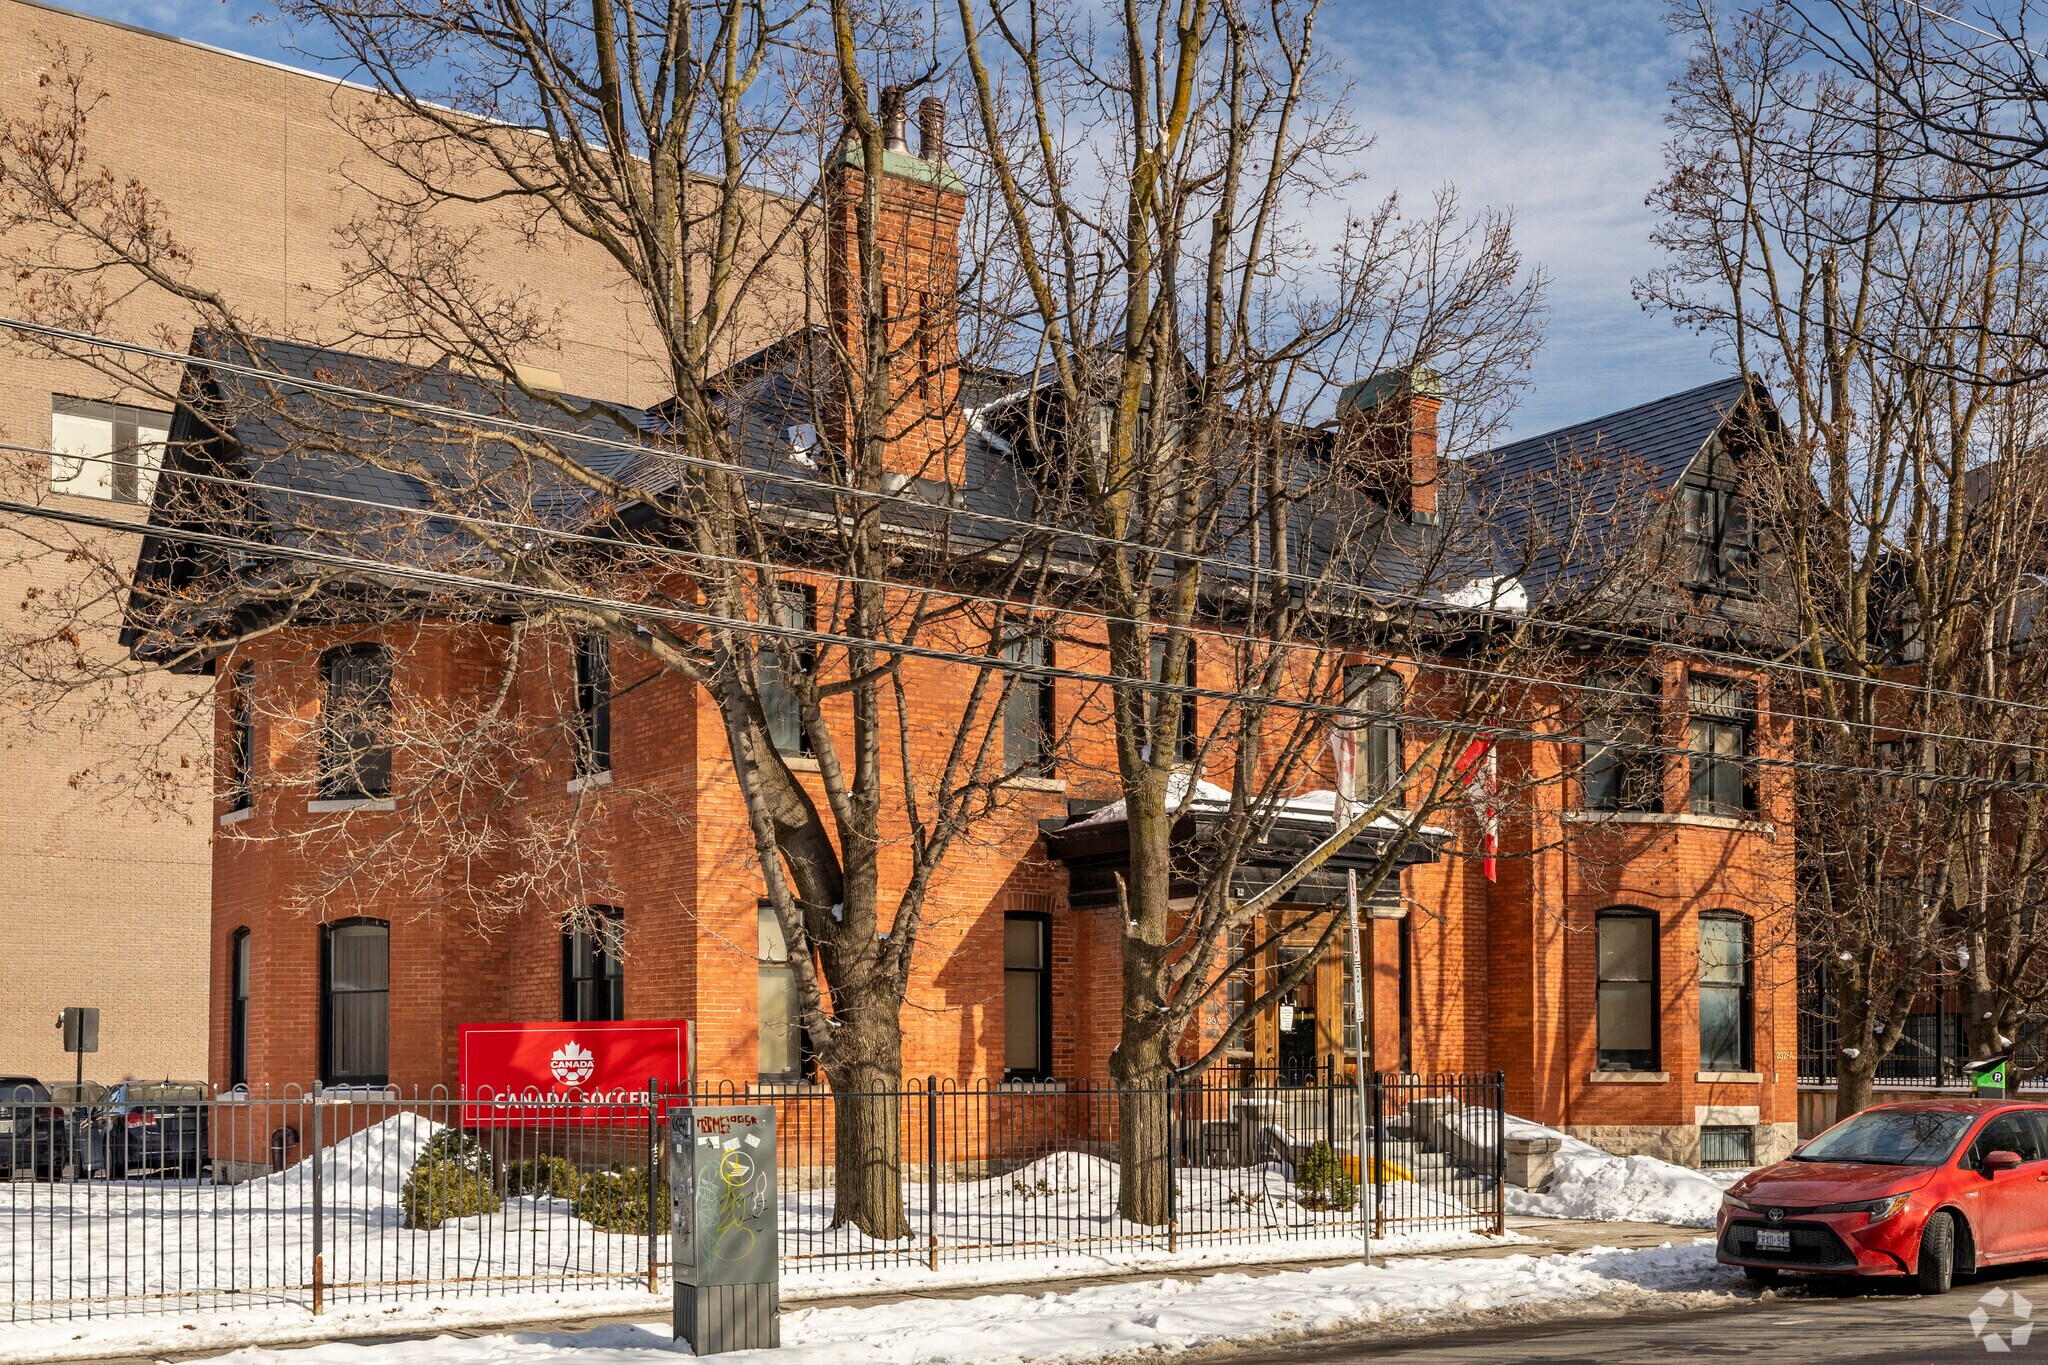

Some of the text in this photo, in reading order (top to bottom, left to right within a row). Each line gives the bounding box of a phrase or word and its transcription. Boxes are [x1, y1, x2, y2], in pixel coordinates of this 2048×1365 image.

[550, 1060, 594, 1069] CANADA
[494, 1091, 651, 1109] CANADA SOCCER
